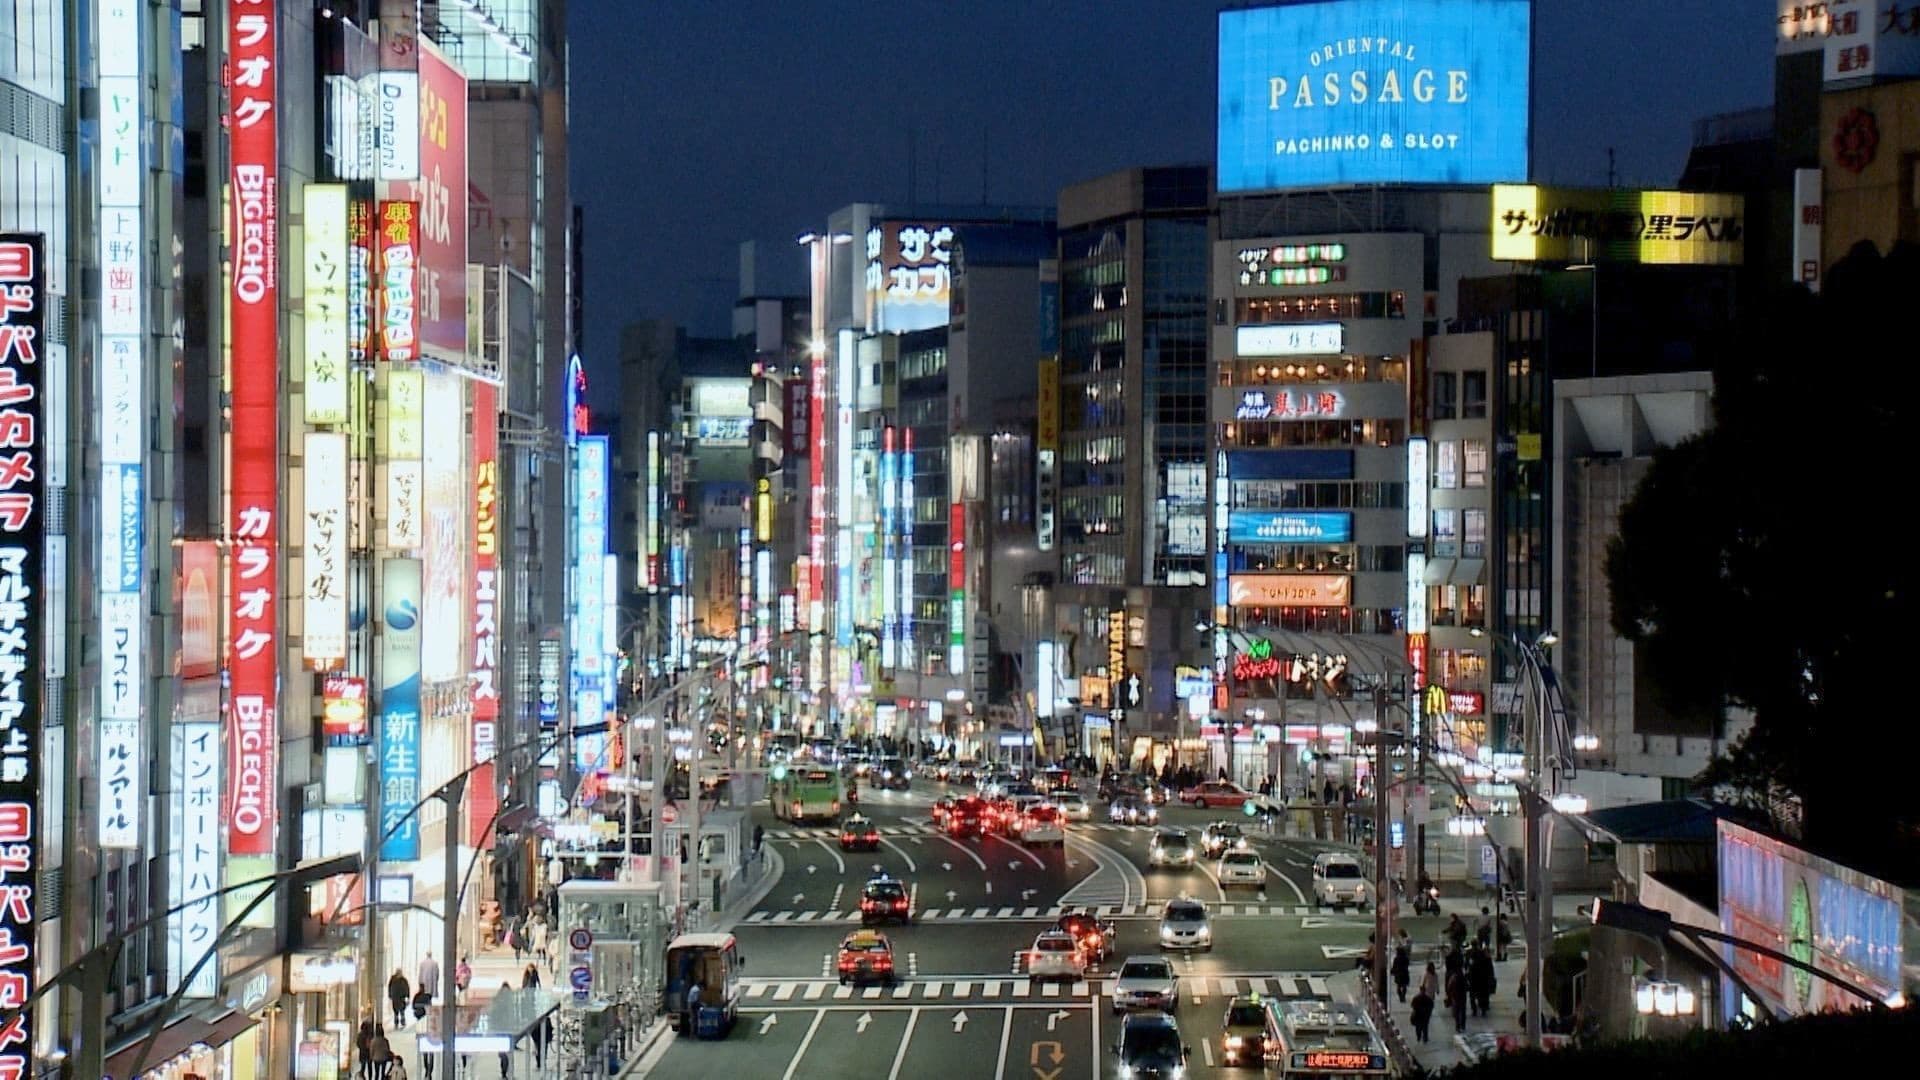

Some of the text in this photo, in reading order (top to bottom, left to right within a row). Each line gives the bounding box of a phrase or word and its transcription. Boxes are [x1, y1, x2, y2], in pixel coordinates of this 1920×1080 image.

[235, 0, 271, 129] ラオケ
[1269, 69, 1468, 110] PASSAGE
[1310, 36, 1416, 67] ORIENTAL
[1276, 133, 1459, 154] PACHINKO & SLOT
[476, 461, 495, 556] パチンコ
[236, 507, 272, 660] カラオケ
[474, 570, 496, 698] エスパス
[106, 743, 131, 831] ルノアール
[384, 711, 417, 841] 新生銀行
